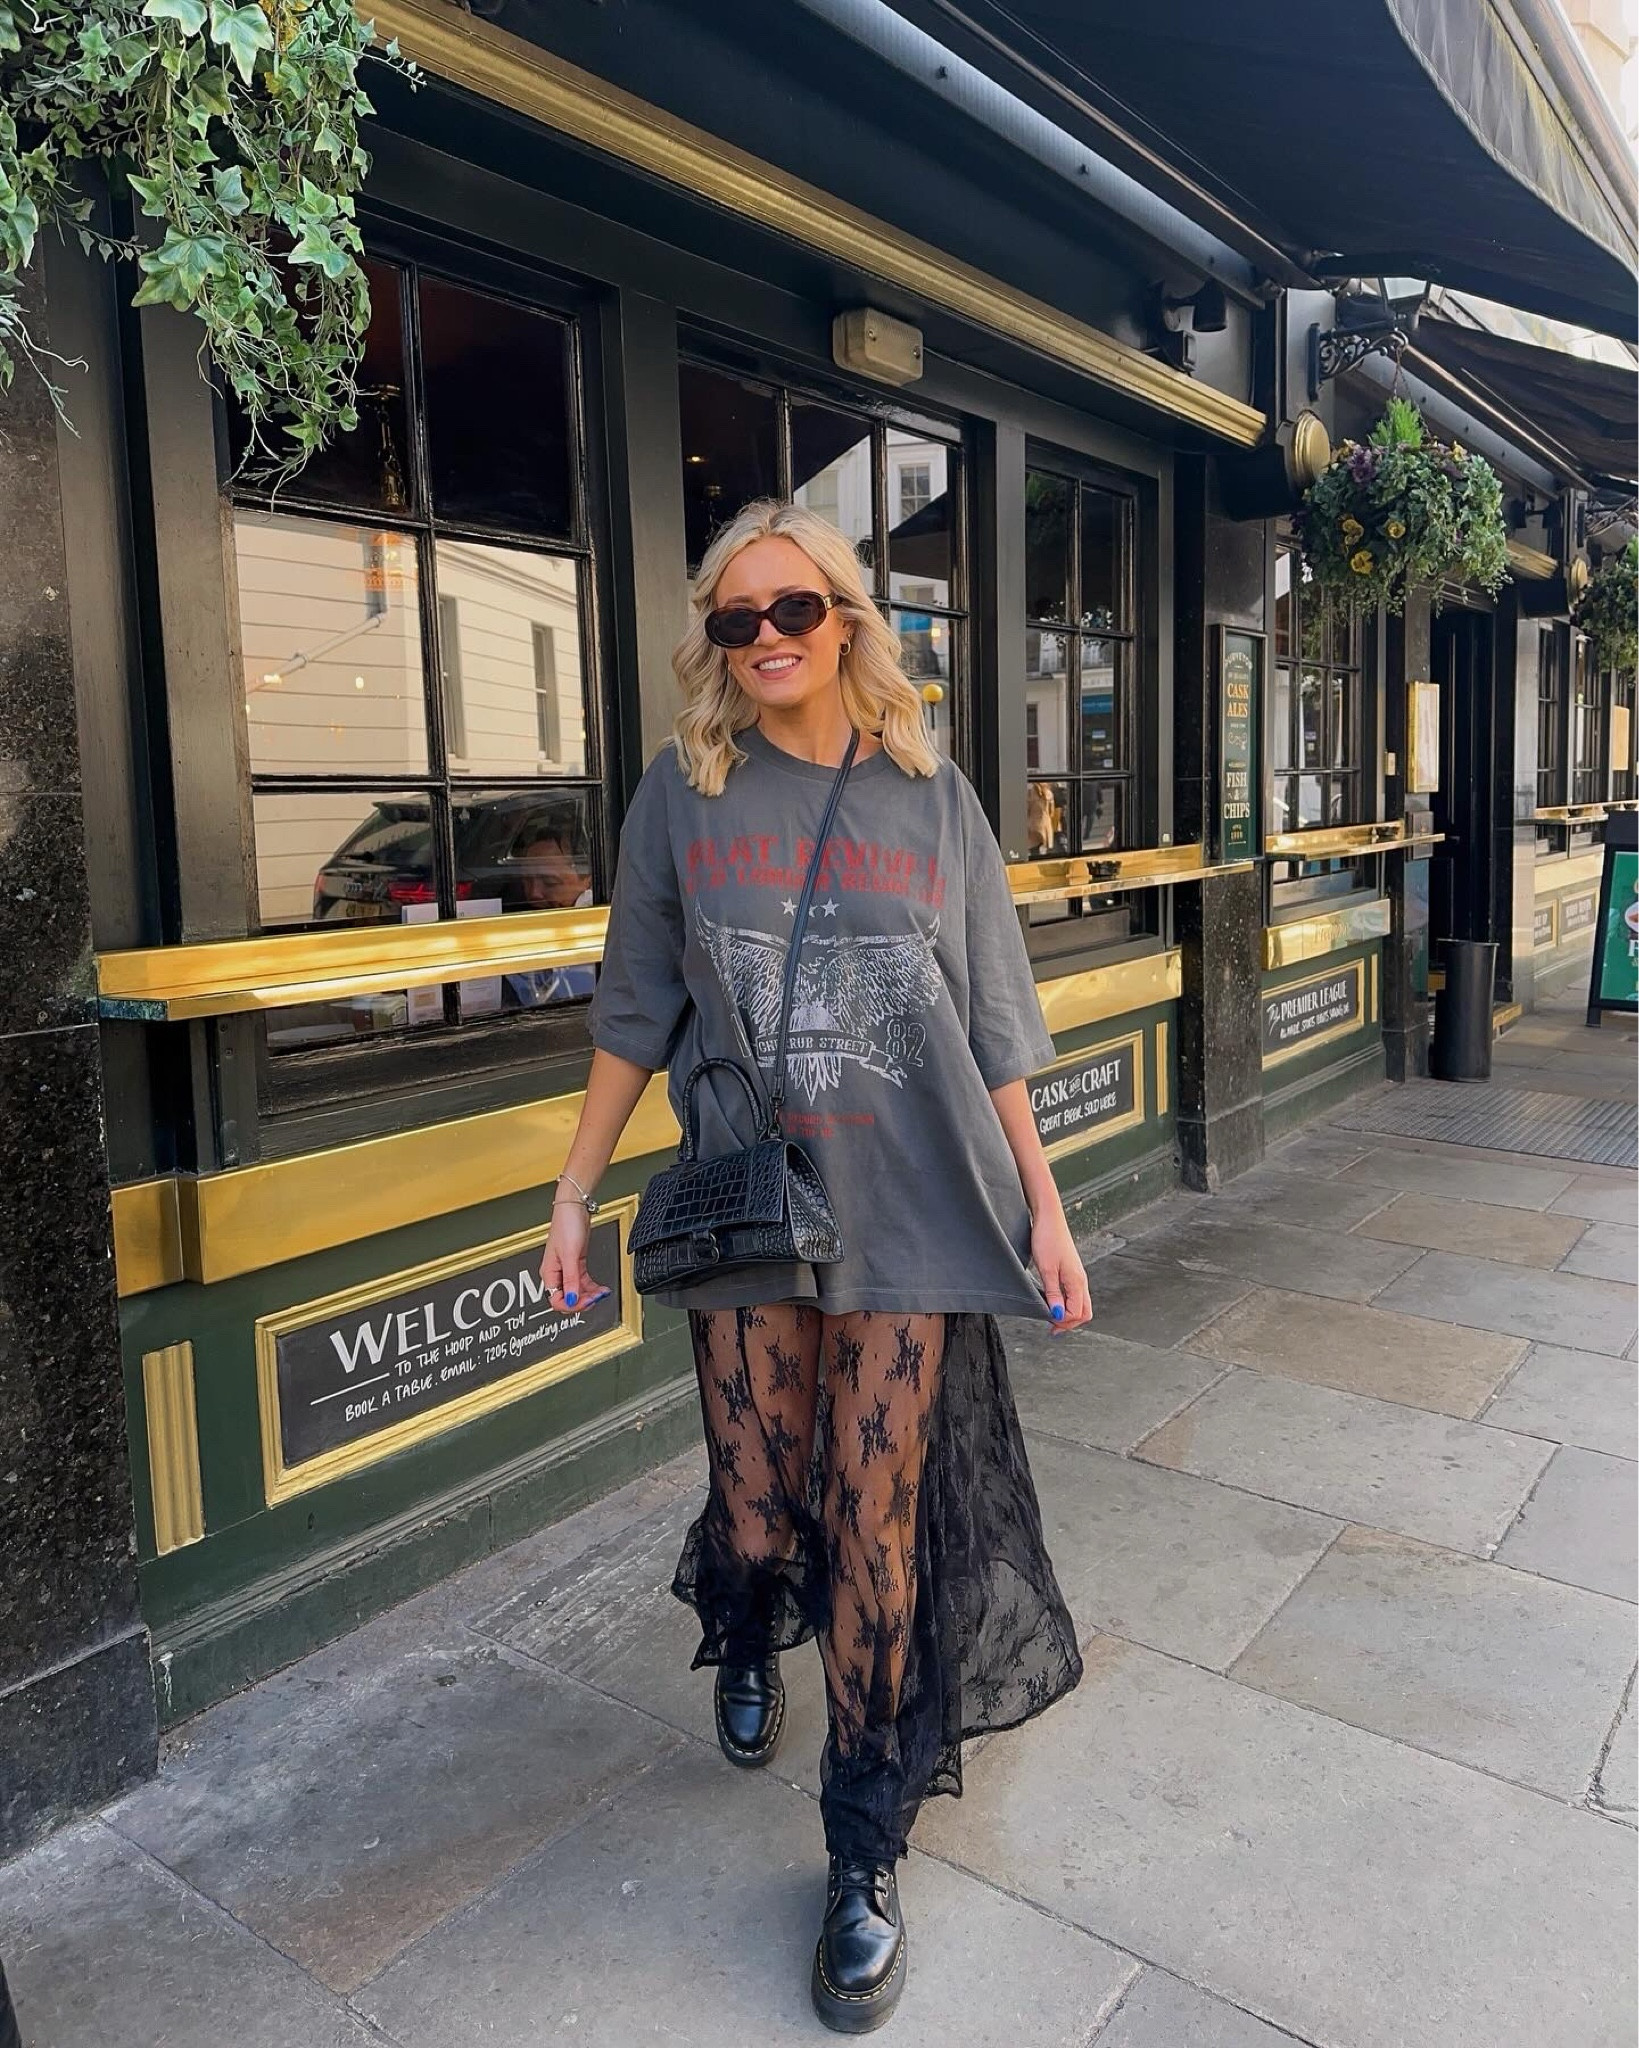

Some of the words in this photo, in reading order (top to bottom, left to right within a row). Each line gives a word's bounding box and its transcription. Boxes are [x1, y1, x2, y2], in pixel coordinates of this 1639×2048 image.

[1227, 683, 1249, 699] CASK
[1227, 701, 1248, 718] ALES
[1226, 772, 1247, 788] FISH
[1223, 802, 1250, 819] CHIPS
[1281, 992, 1319, 1021] PREMIER
[1320, 980, 1347, 1007] LEAGUE
[819, 1037, 867, 1053] STREET
[1031, 1077, 1069, 1112] CASK
[1082, 1058, 1121, 1093] CRAFT
[1040, 1112, 1062, 1135] GREAT
[330, 1269, 546, 1374] WELCOM
[394, 1360, 412, 1377] TO
[416, 1347, 440, 1369] THE
[445, 1335, 474, 1357] HOOP
[479, 1325, 501, 1344] AND
[345, 1396, 379, 1422] BOOK
[381, 1390, 391, 1406] A
